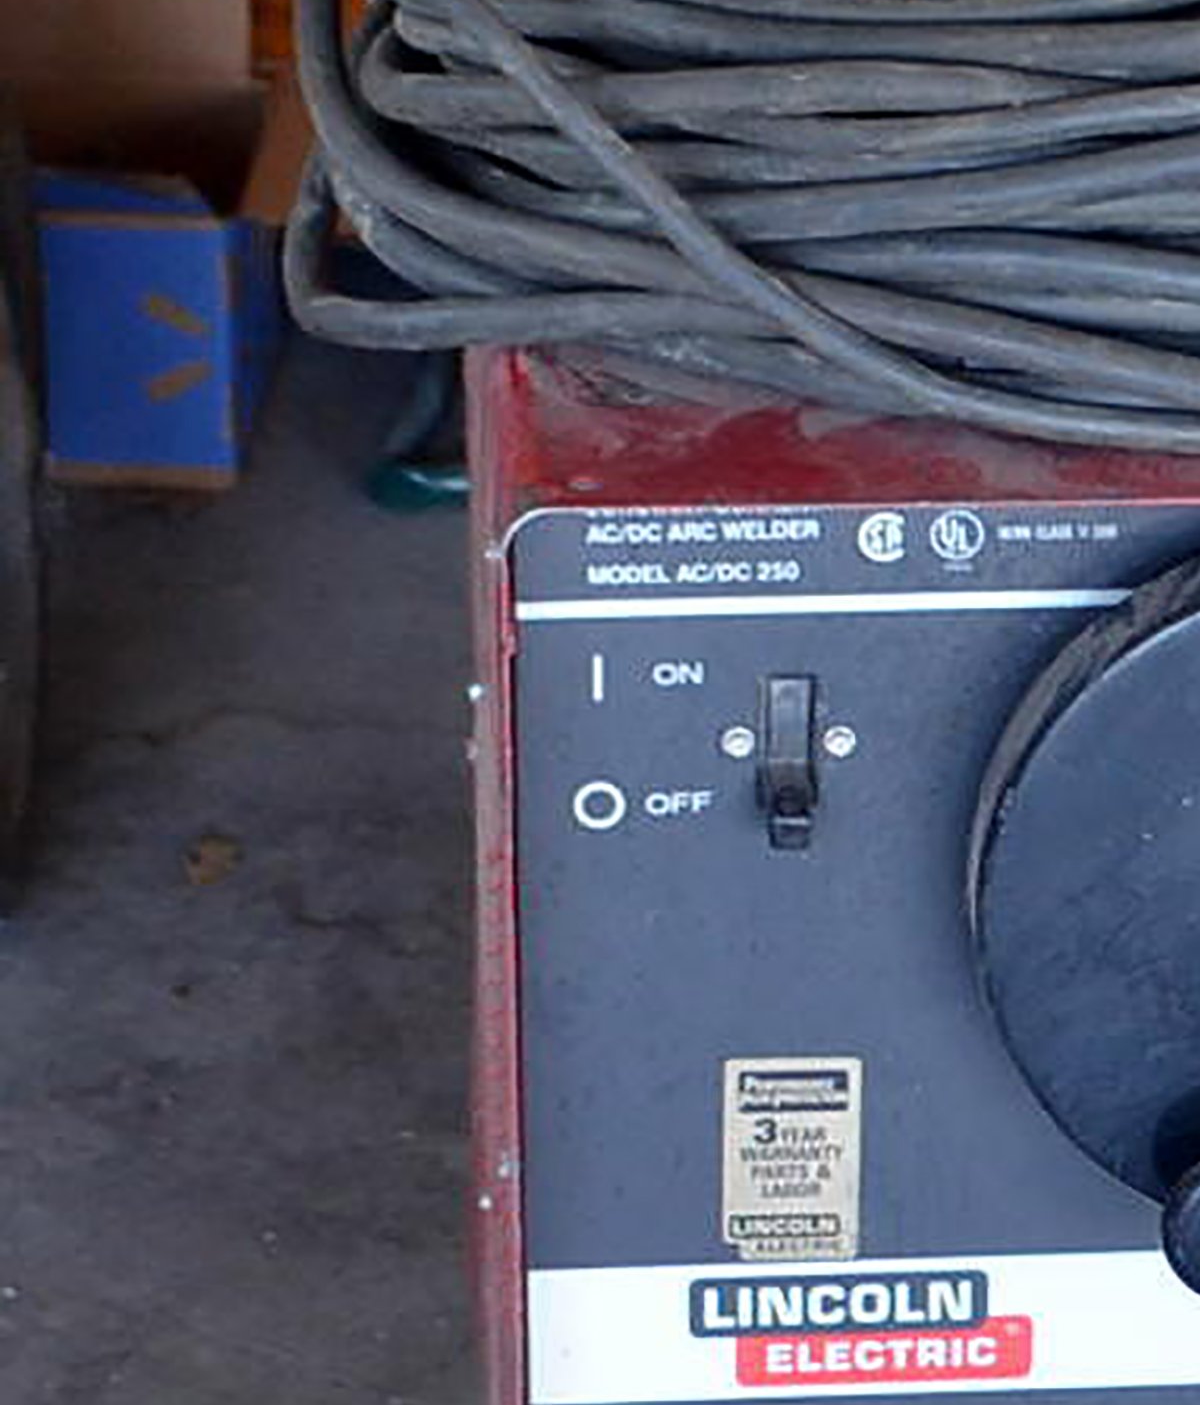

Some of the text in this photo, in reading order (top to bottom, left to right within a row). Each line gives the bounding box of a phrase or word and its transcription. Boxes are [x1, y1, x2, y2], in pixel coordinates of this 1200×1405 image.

[668, 521, 717, 542] ARC
[720, 519, 820, 541] WELDER
[588, 564, 671, 584] MODEL
[677, 562, 750, 583] AC/DC
[652, 662, 704, 685] ON
[645, 792, 712, 816] OFF
[753, 1118, 777, 1143] 3
[703, 1280, 973, 1330] LINCOLN
[766, 1337, 997, 1373] ELECTRIC
